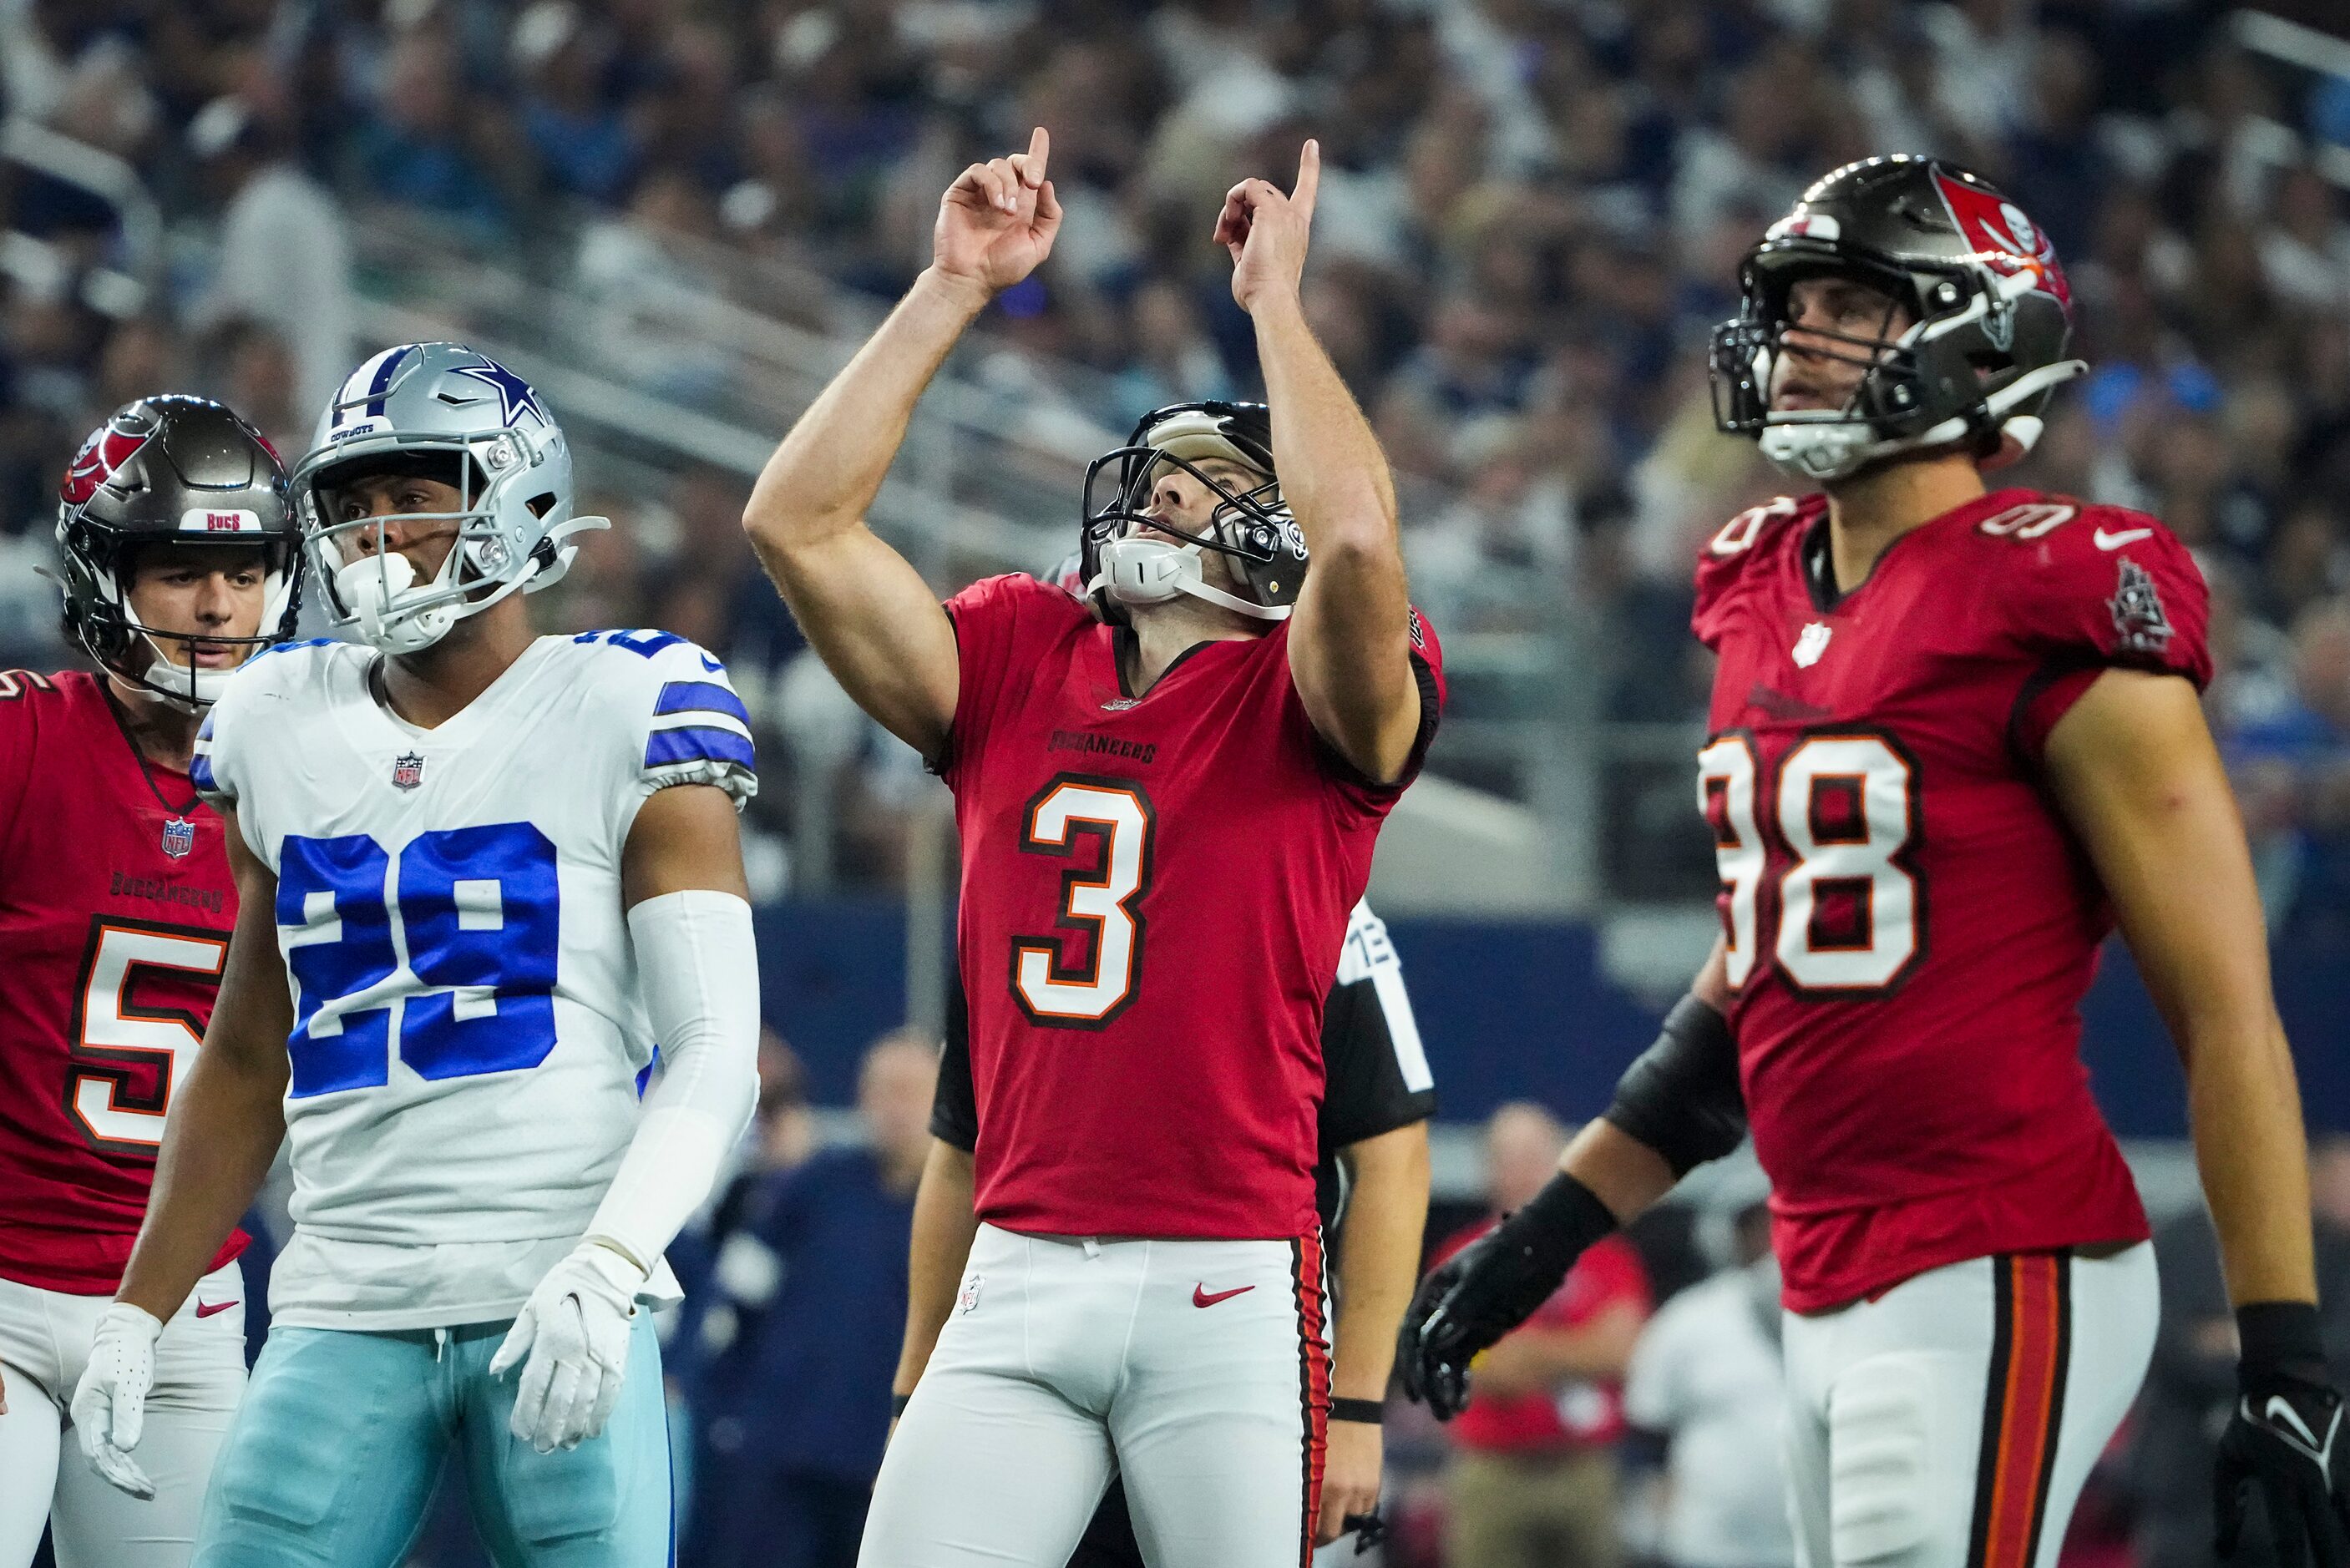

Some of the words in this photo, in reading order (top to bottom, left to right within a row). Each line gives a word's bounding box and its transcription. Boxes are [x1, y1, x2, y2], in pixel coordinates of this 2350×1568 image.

[331, 423, 374, 443] COWBOYS
[165, 836, 189, 852] NFL
[275, 821, 560, 1099] 29
[1008, 771, 1157, 1032] 3
[1697, 727, 1928, 1003] 98
[63, 913, 233, 1155] 5
